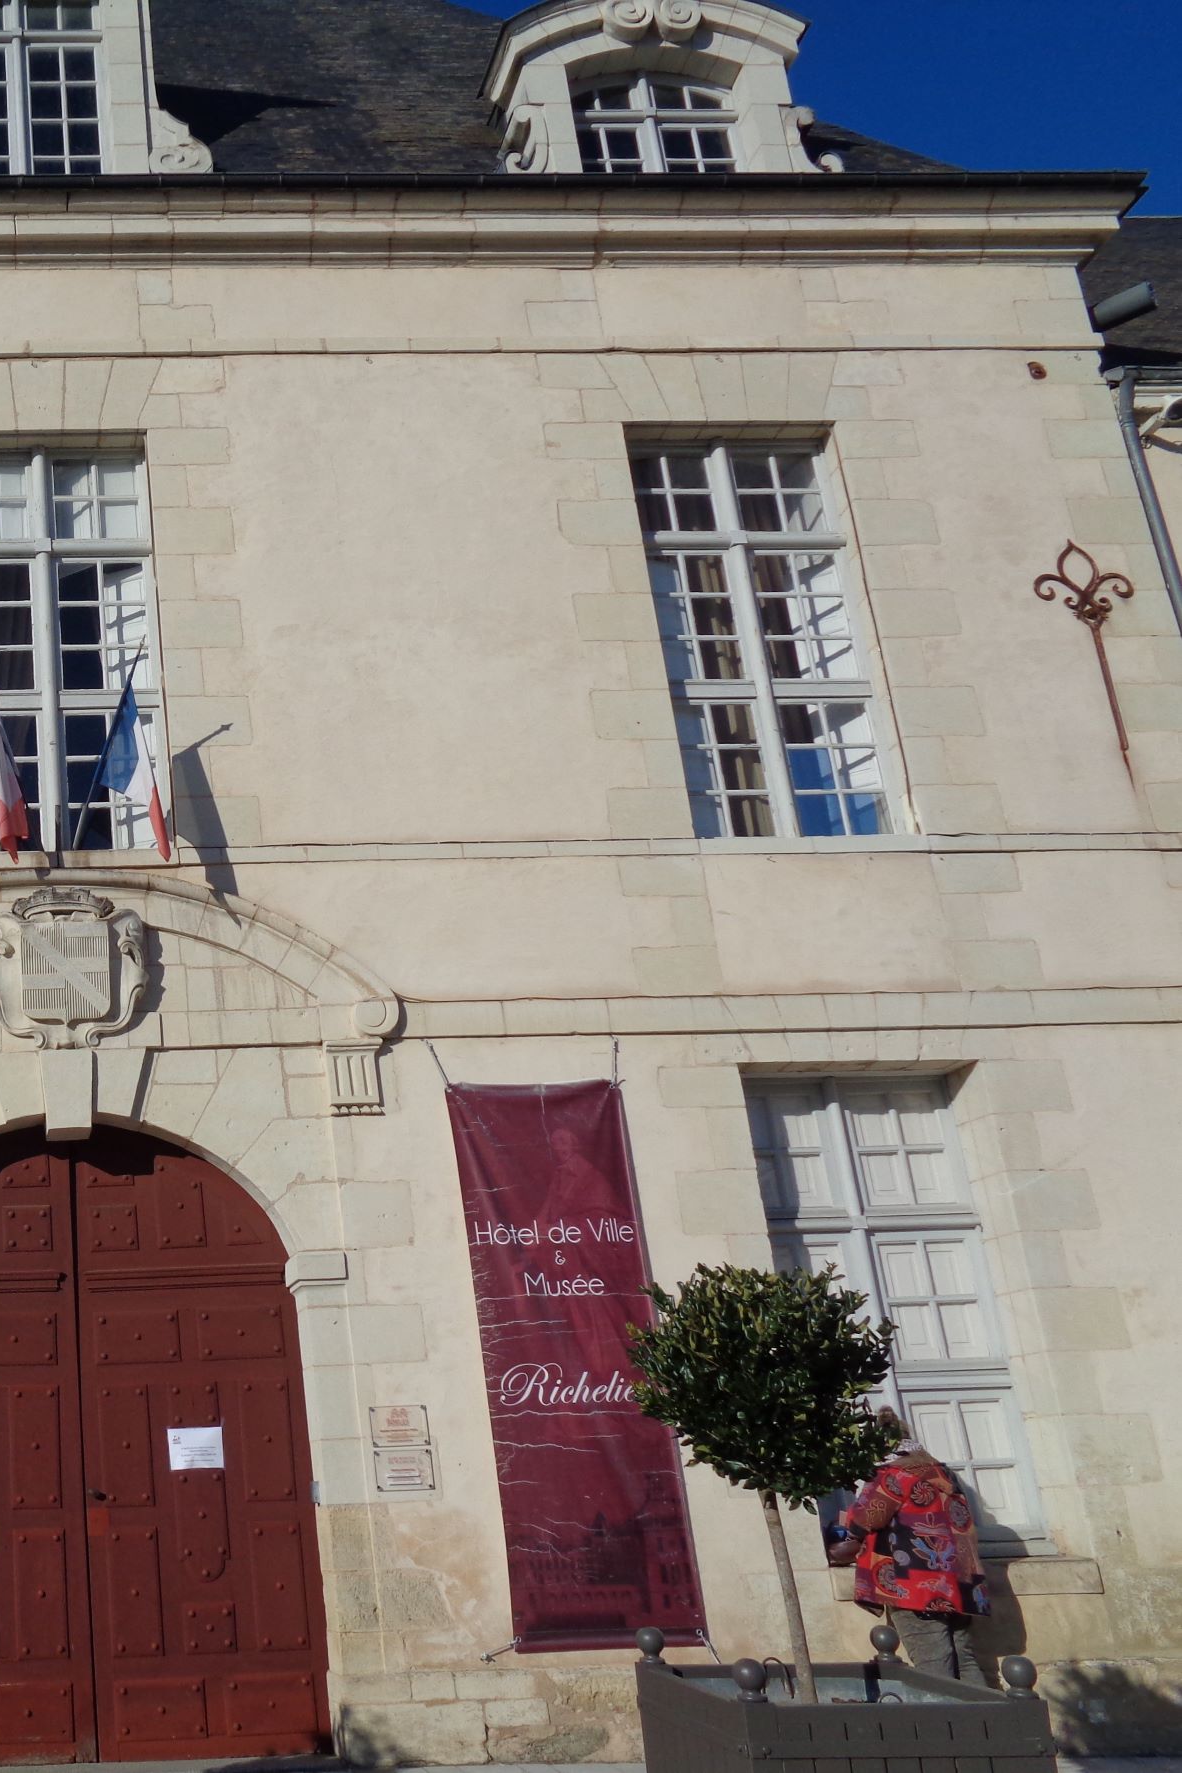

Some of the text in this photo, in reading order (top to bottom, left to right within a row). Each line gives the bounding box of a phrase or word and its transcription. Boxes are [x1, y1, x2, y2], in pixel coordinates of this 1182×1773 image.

[474, 1217, 634, 1245] Hôtel de Ville
[554, 1249, 566, 1266] &
[523, 1271, 605, 1297] Musée
[499, 1362, 636, 1406] Richelie
